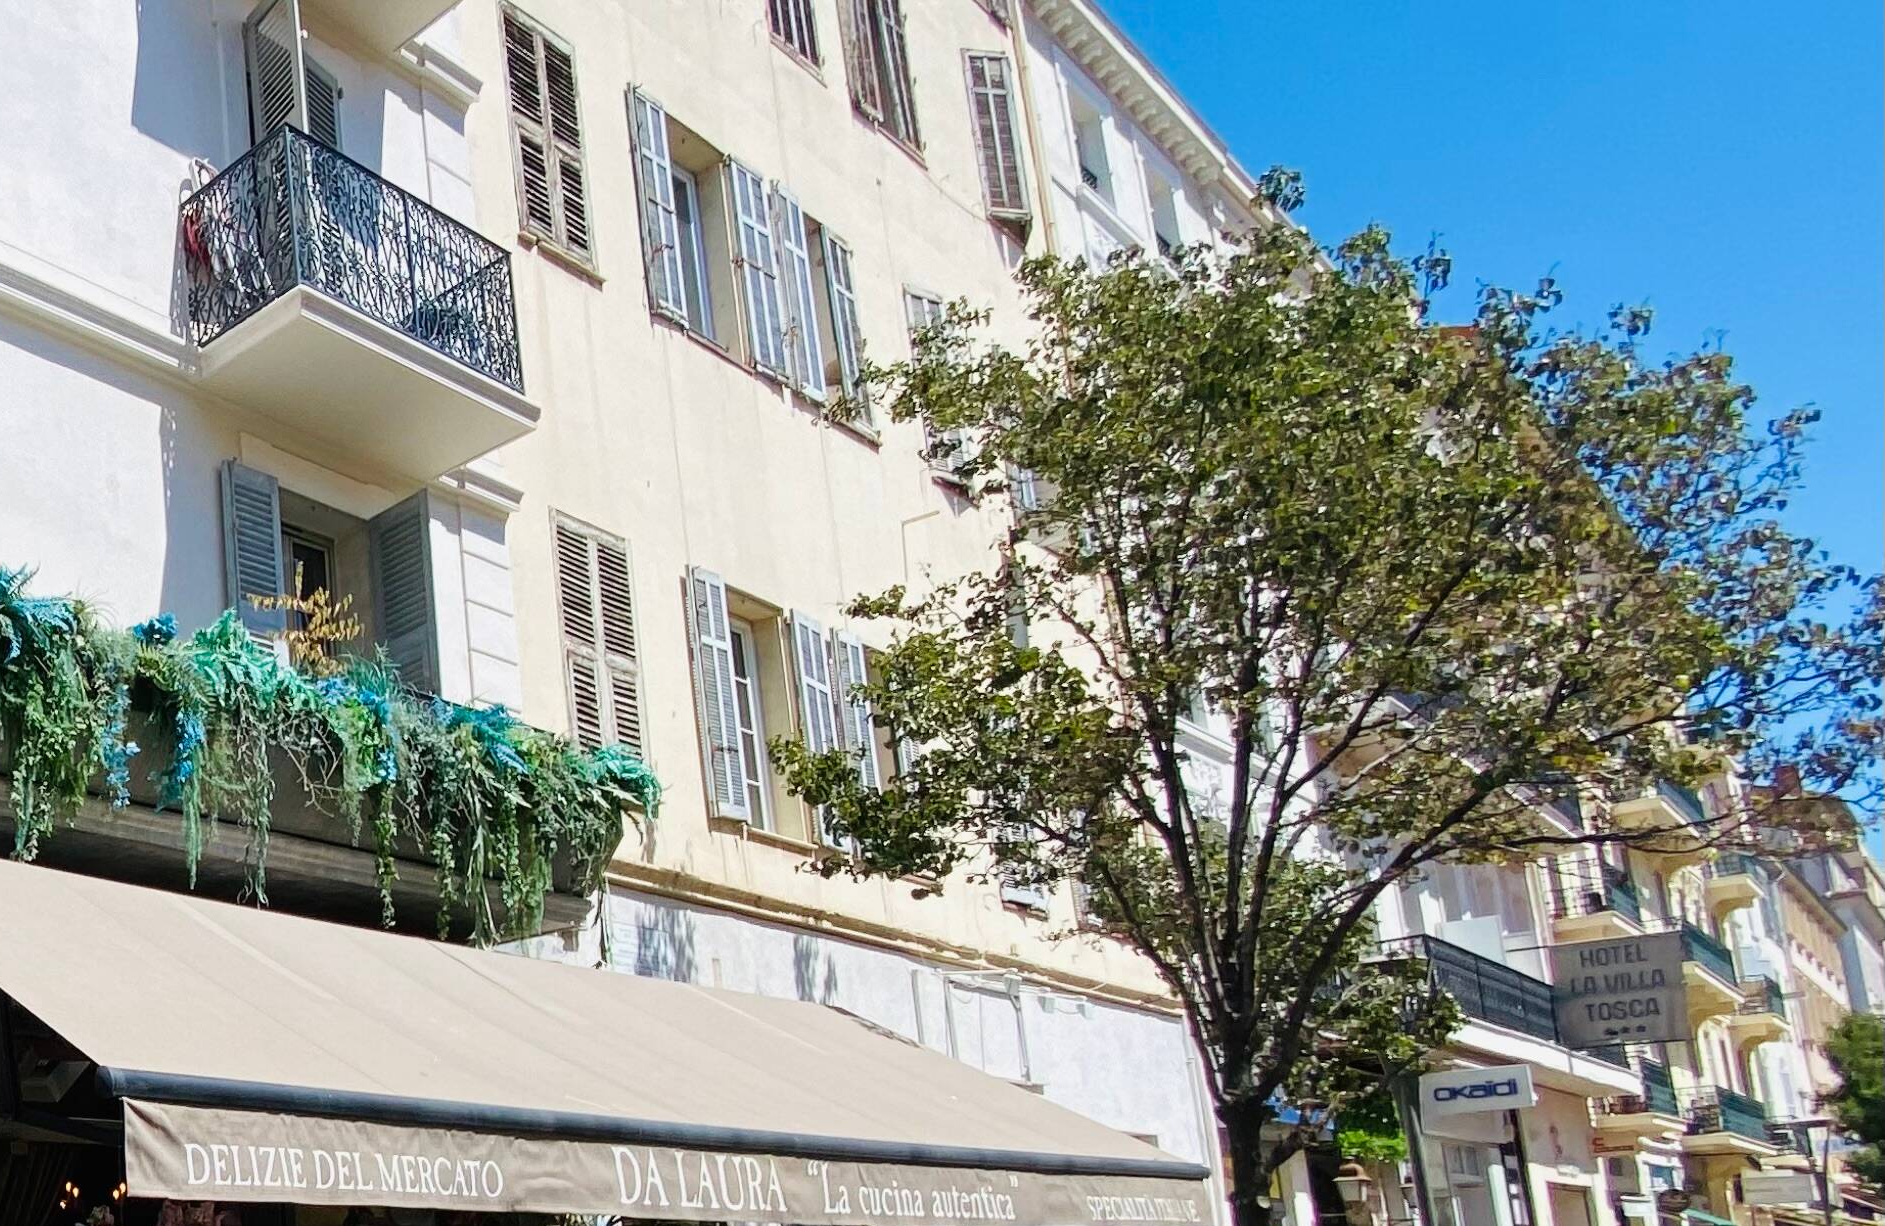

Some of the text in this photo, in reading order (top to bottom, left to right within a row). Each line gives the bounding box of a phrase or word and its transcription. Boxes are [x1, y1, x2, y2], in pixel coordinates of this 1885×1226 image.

[1579, 943, 1648, 968] HOTEL
[1603, 968, 1665, 993] VILLA
[1585, 997, 1660, 1021] TOSCA
[184, 1143, 504, 1198] DELIZIE DEL MERCATO
[610, 1145, 788, 1212] DA LAURA
[859, 1179, 925, 1217] cucina
